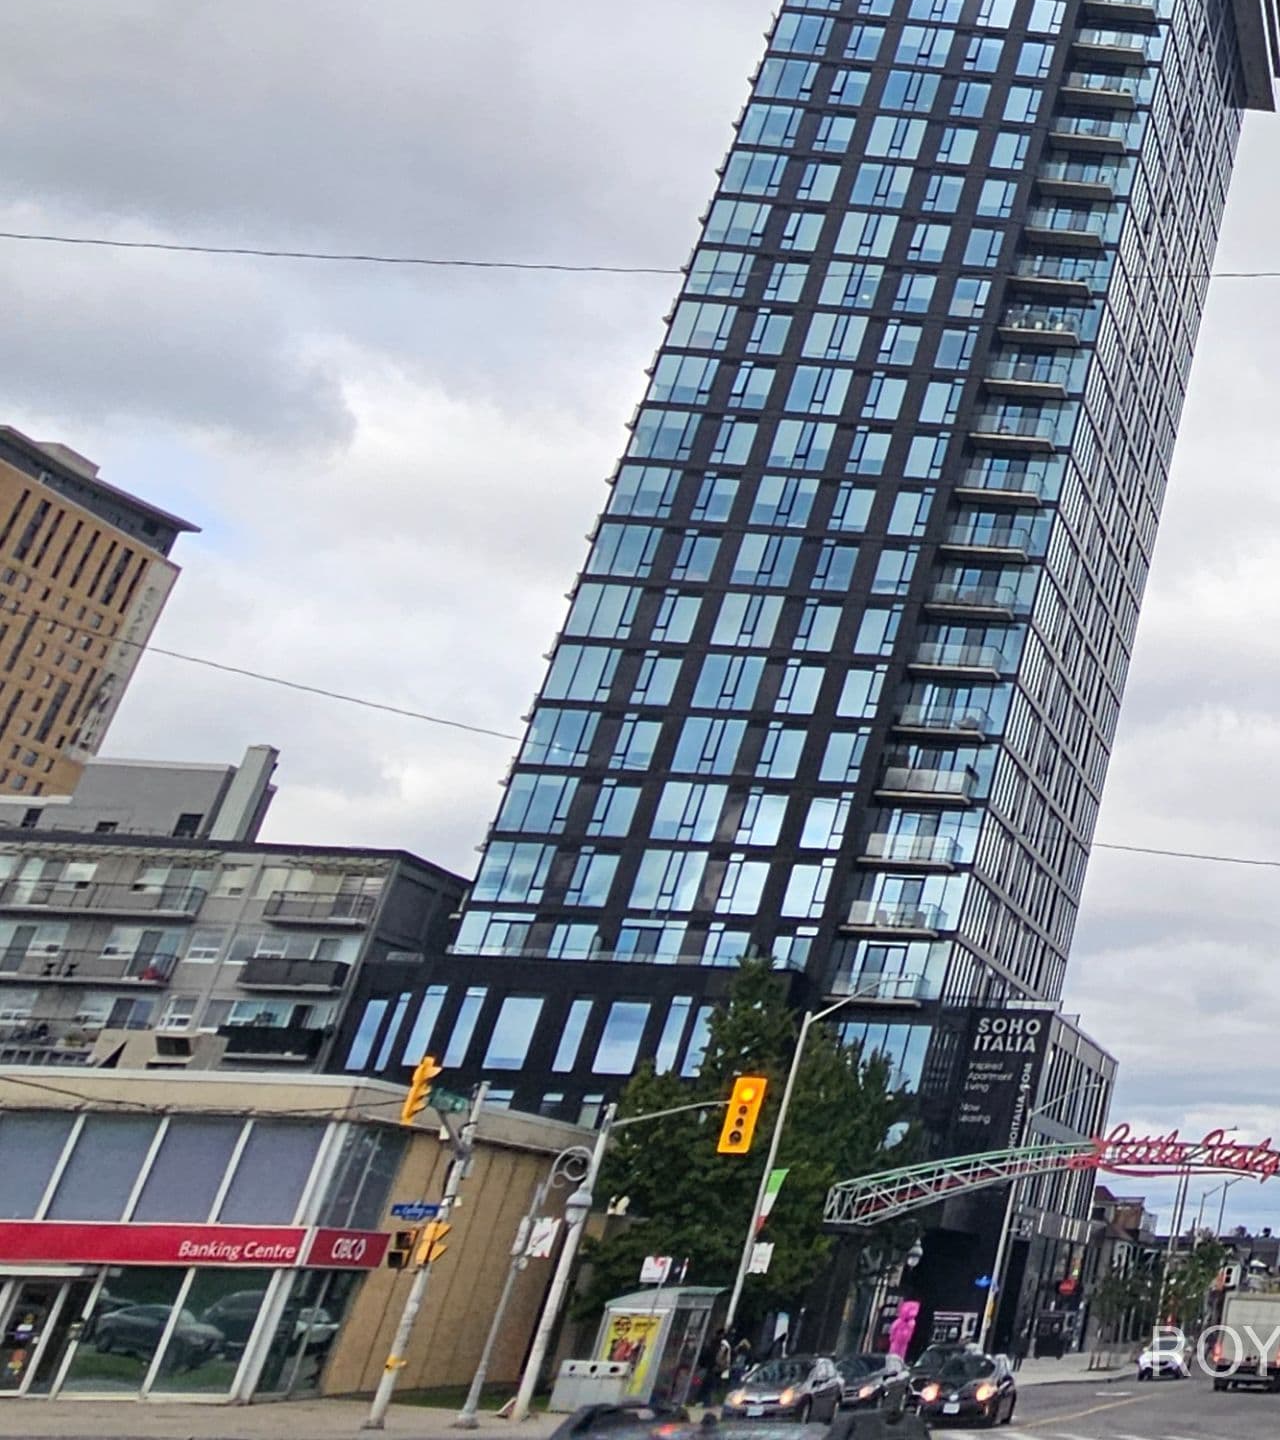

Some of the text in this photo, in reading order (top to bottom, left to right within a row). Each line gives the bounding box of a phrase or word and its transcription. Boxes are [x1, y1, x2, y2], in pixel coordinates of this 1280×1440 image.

[977, 1017, 1042, 1036] SOHO
[973, 1034, 1037, 1053] ITALIA
[177, 1240, 297, 1261] Banking Centre
